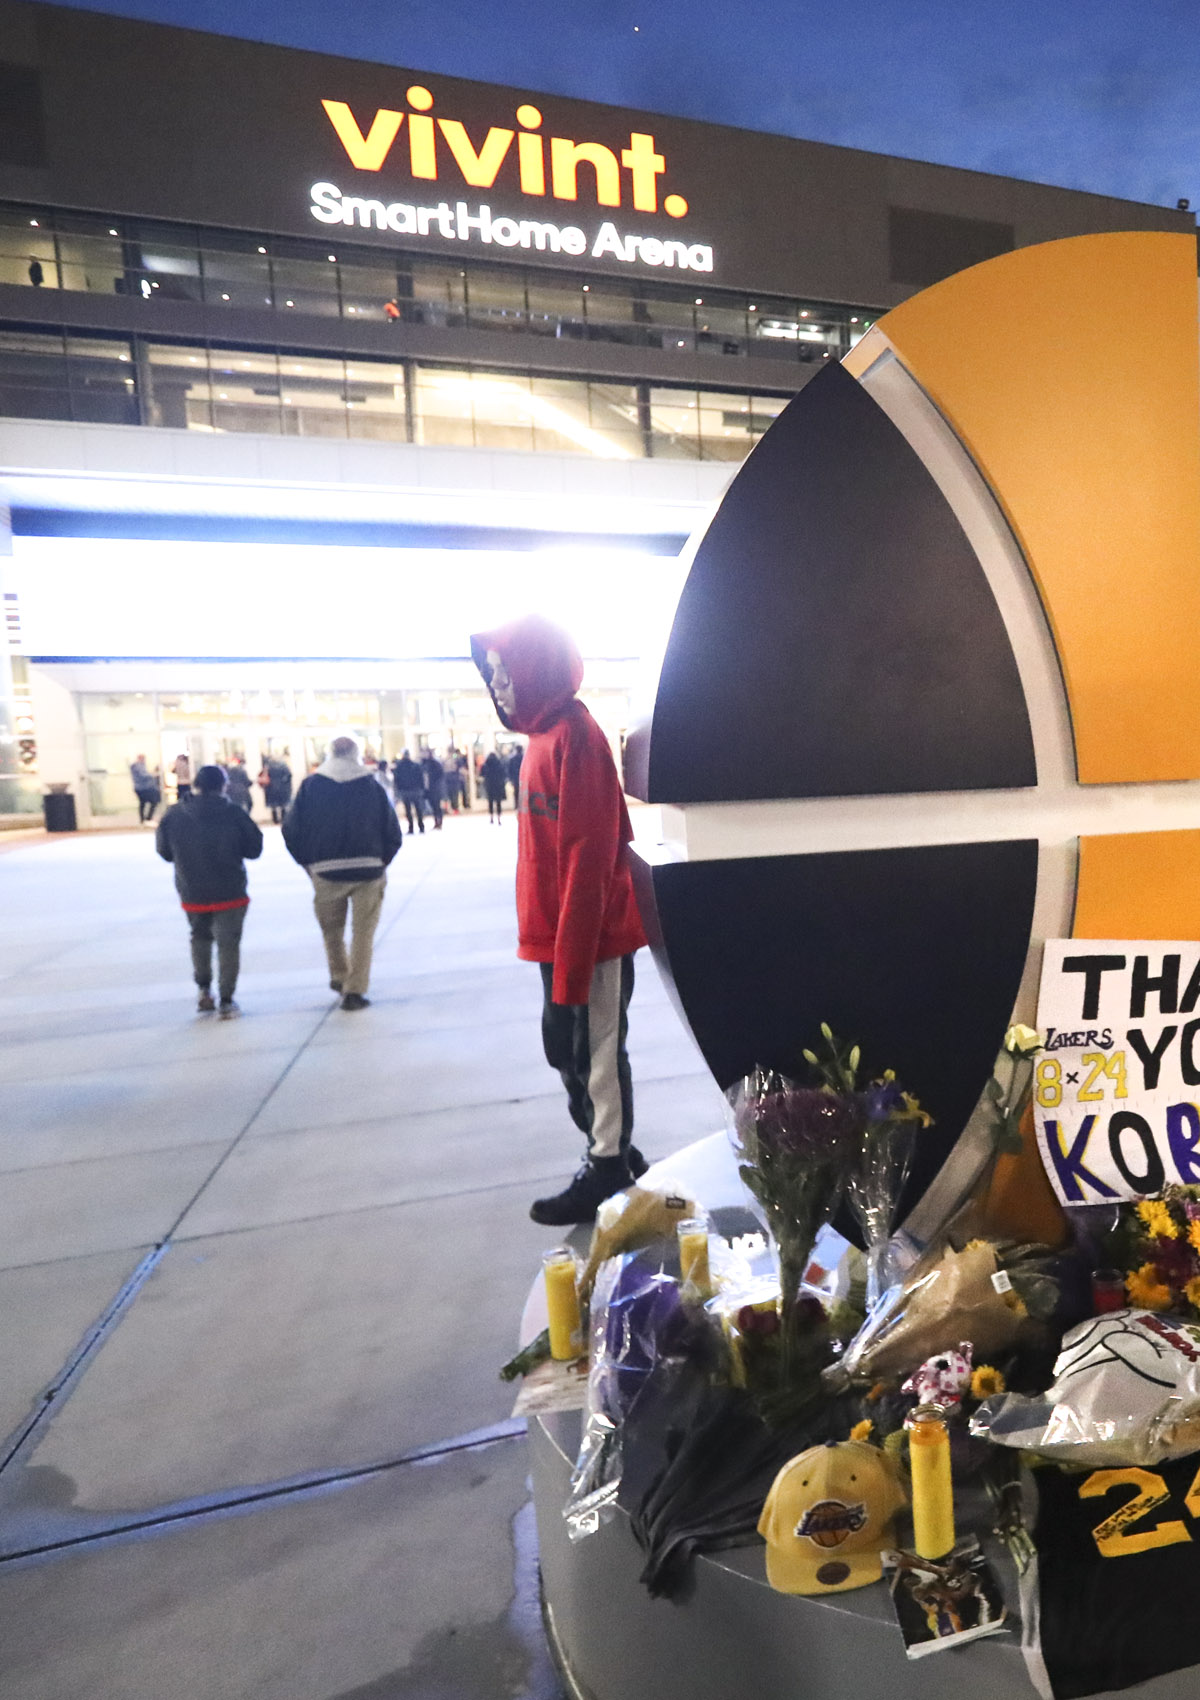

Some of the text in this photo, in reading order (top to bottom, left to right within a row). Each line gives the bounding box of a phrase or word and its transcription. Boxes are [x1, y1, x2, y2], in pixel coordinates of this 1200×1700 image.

[321, 85, 689, 219] vivint.
[591, 221, 714, 272] Arena
[1044, 1027, 1115, 1052] LAKERS
